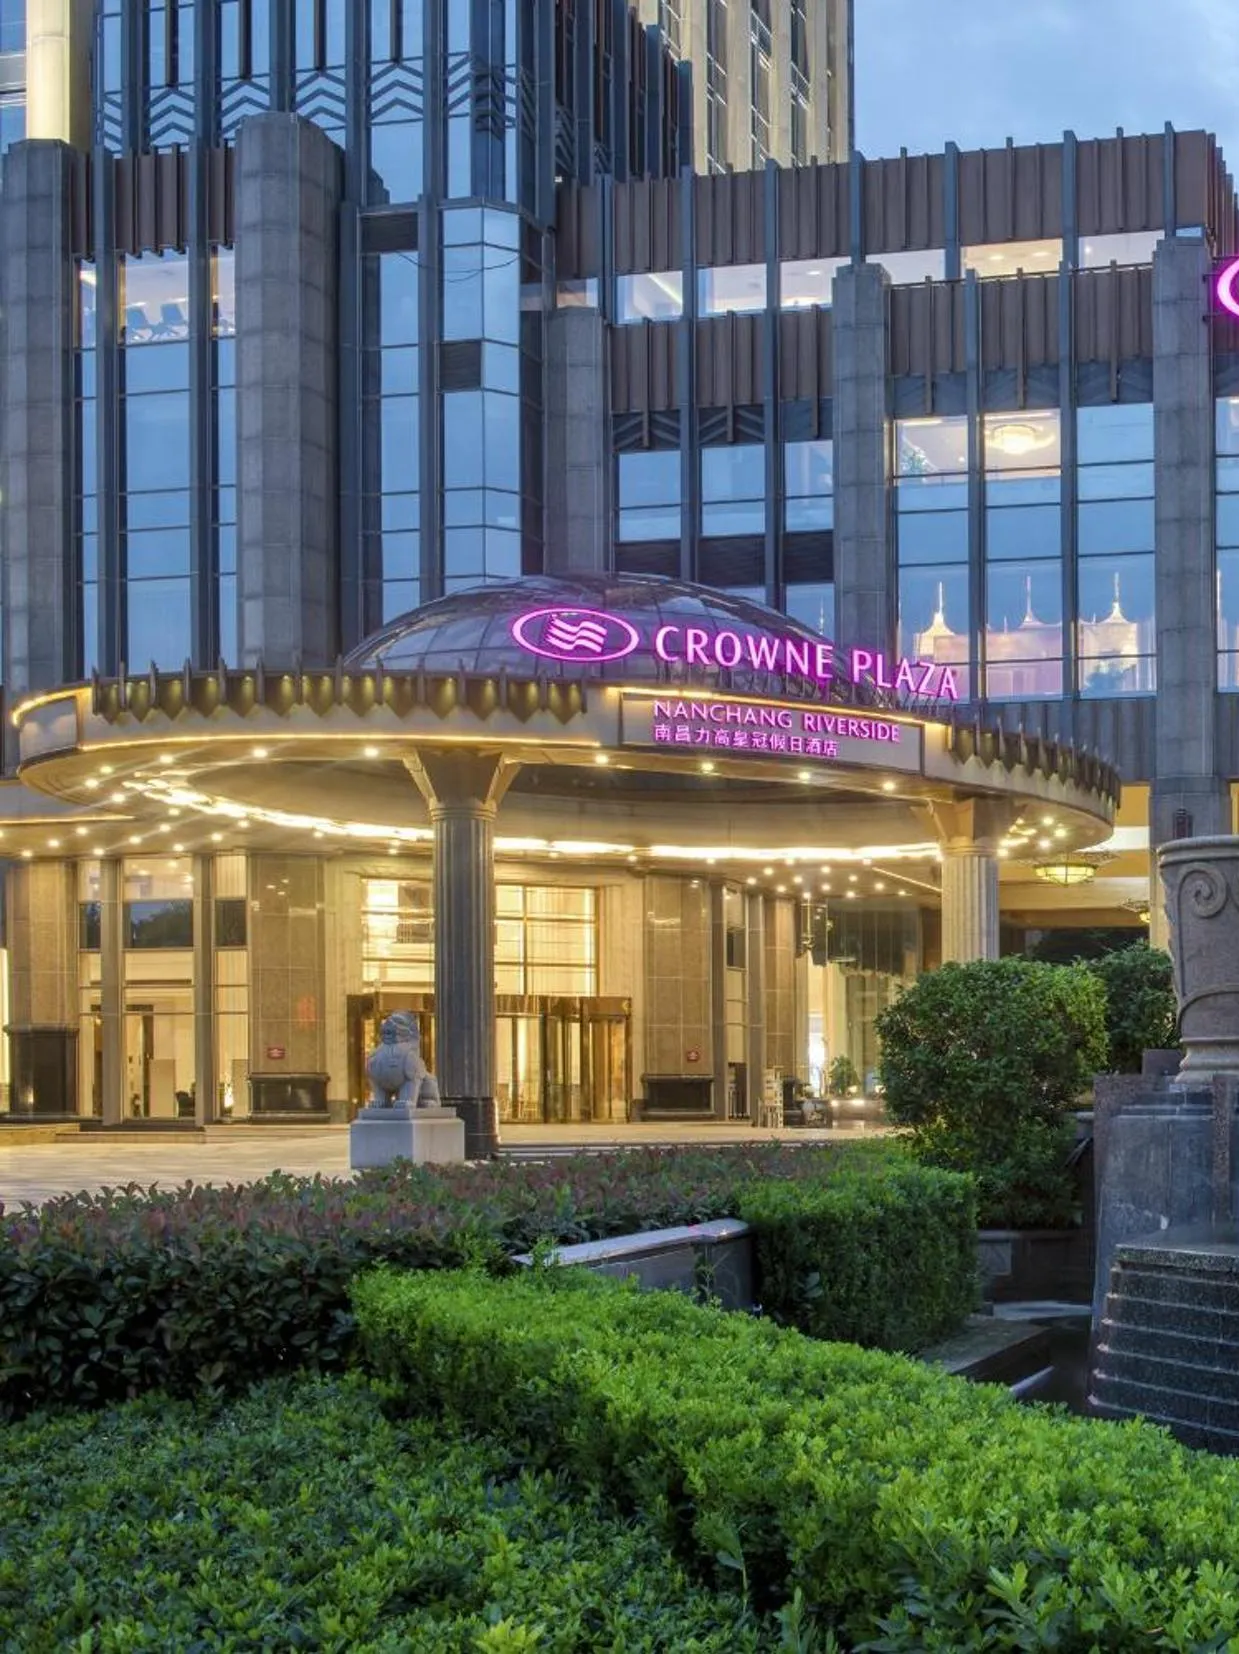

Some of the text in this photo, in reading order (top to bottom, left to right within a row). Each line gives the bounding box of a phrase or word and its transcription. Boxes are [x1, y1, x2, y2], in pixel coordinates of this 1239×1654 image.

[655, 625, 959, 700] CROWNE PLAZA
[653, 700, 901, 743] NANCHANG RIVERSIDE
[654, 723, 838, 757] 南昌力高皇冠假日酒店
